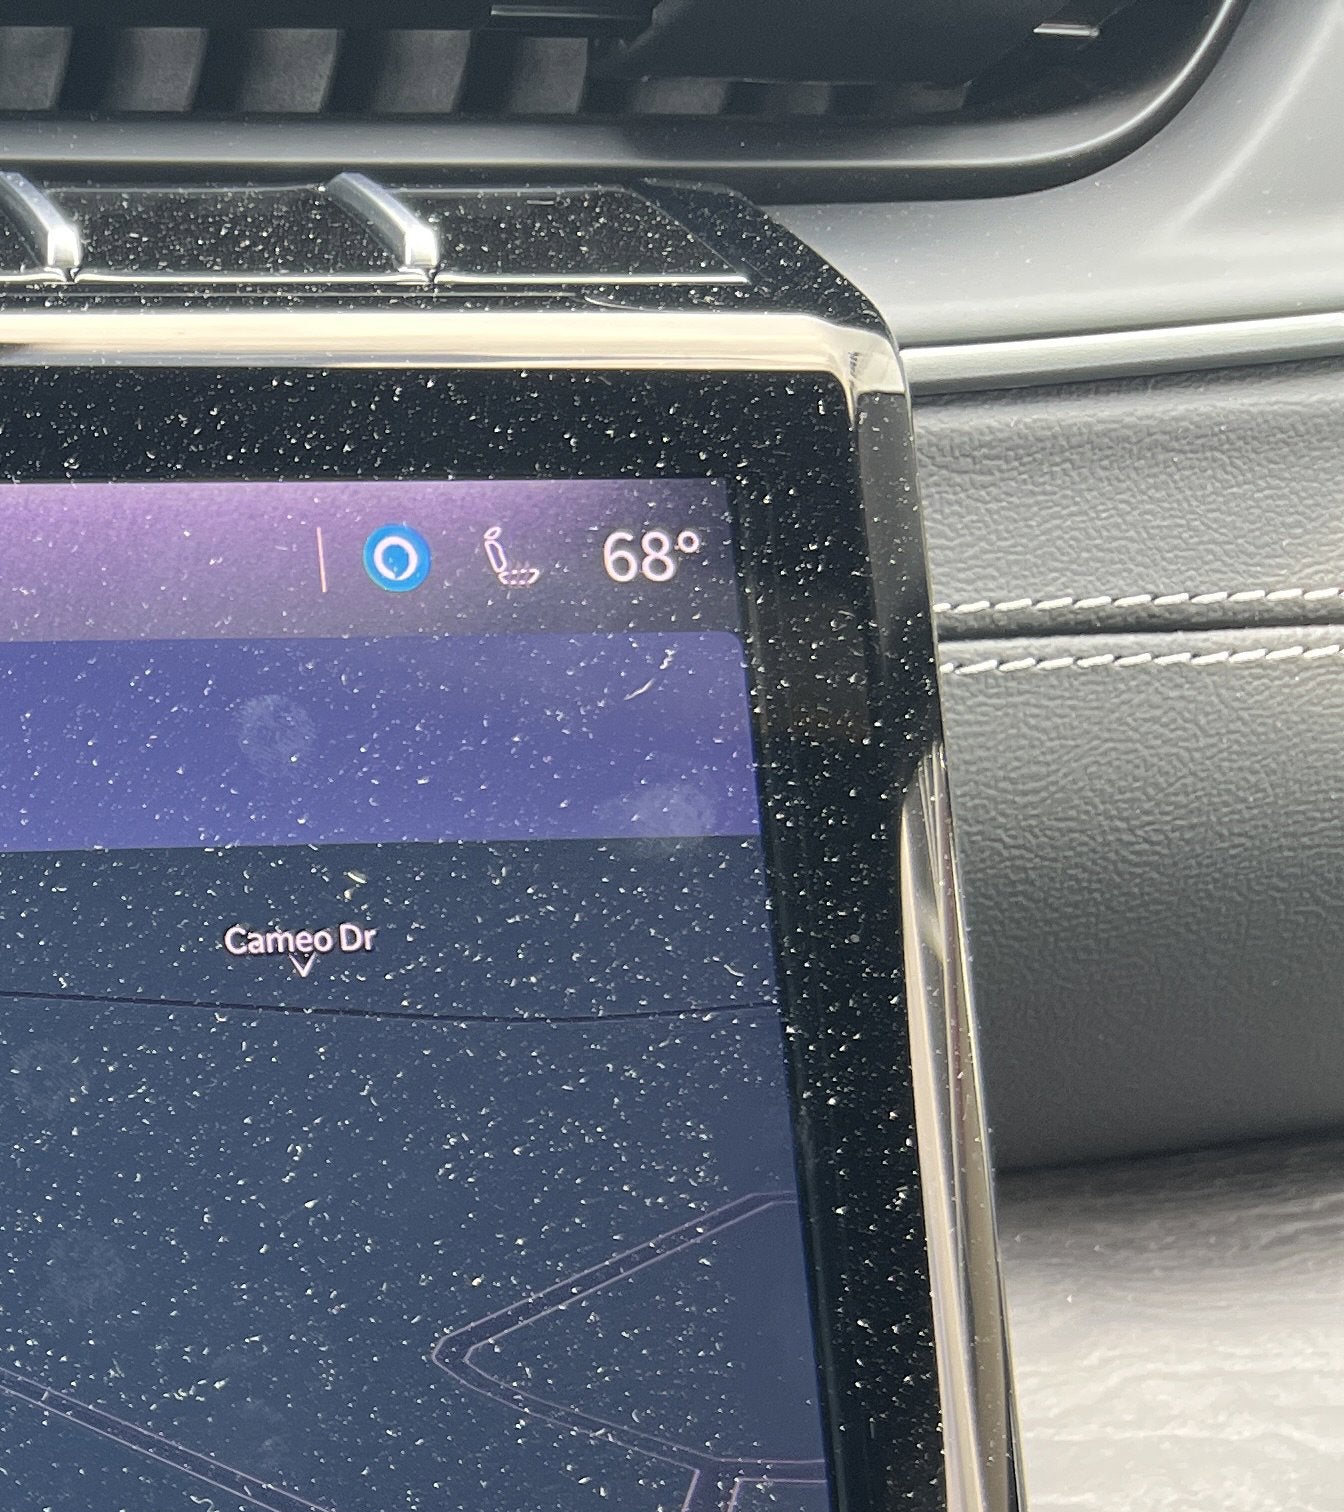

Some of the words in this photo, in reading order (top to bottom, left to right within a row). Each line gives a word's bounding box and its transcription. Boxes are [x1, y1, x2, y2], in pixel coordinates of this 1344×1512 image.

[602, 528, 701, 584] 68°
[225, 925, 331, 955] Cameo
[340, 922, 377, 952] Dr
